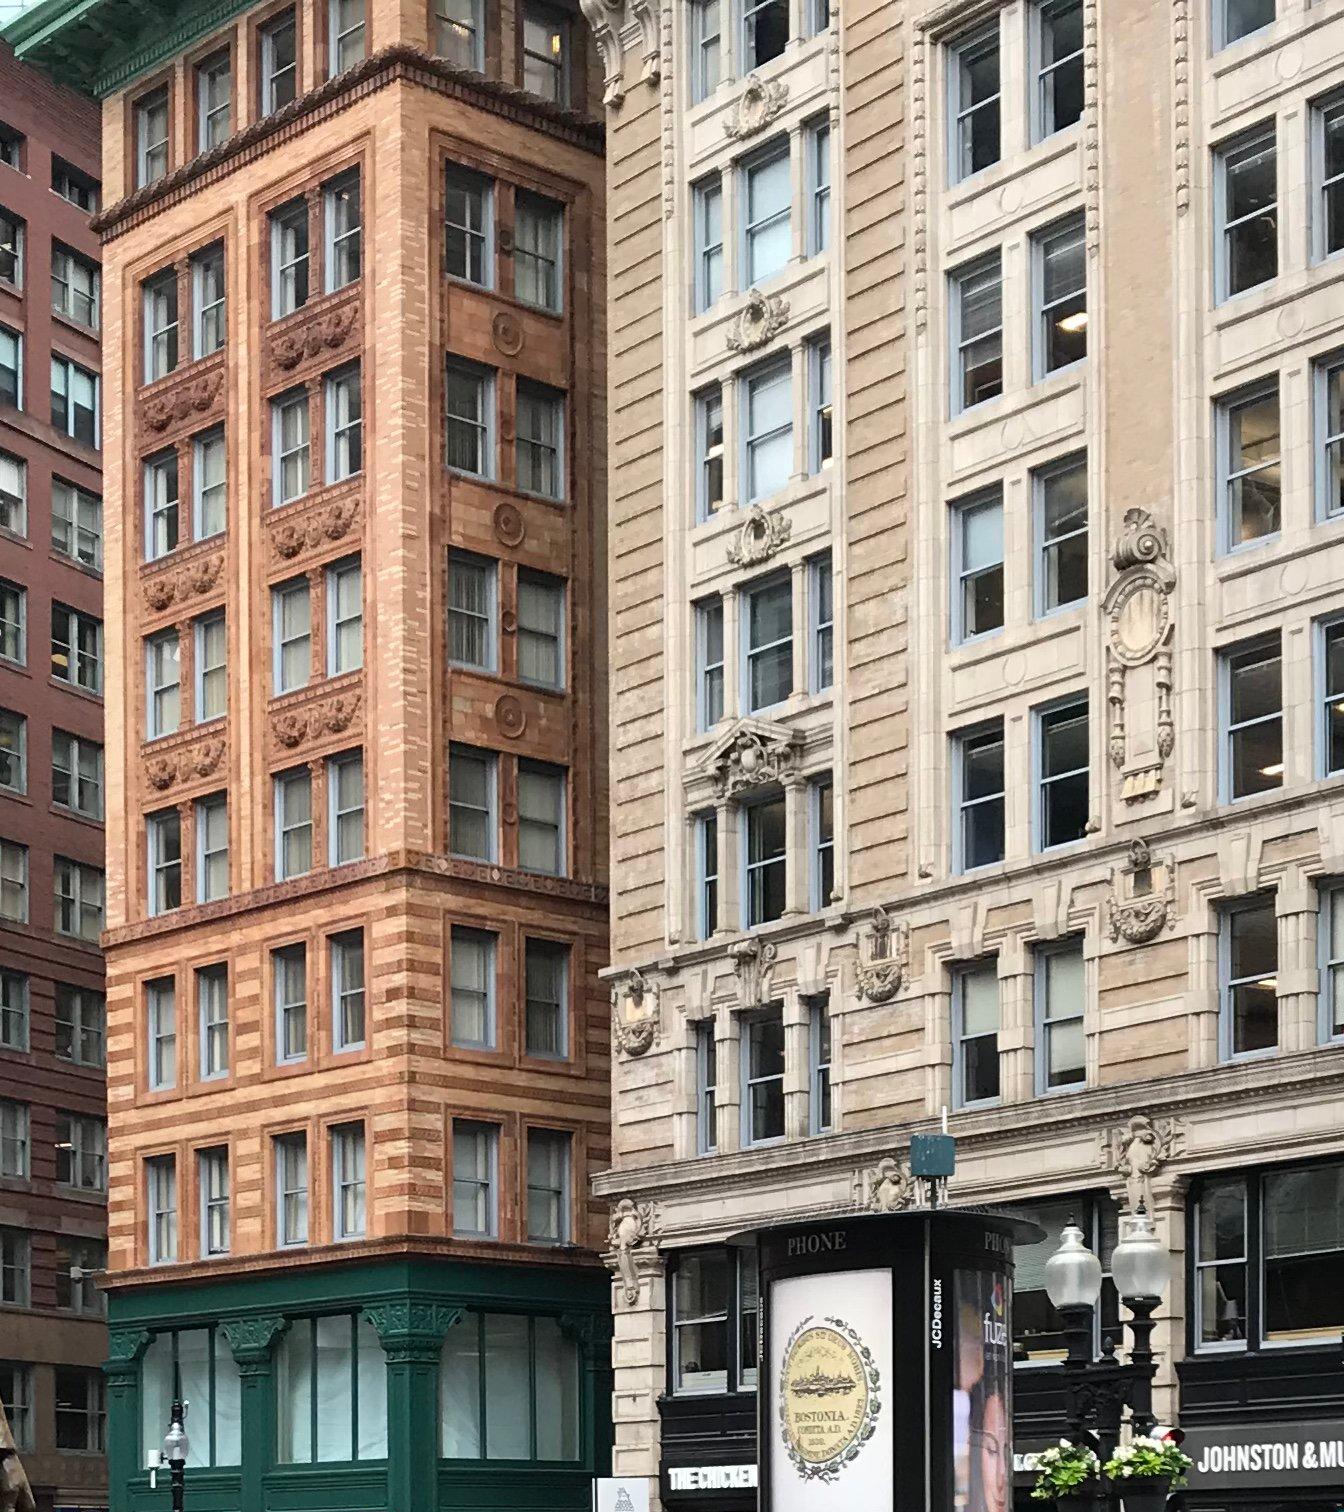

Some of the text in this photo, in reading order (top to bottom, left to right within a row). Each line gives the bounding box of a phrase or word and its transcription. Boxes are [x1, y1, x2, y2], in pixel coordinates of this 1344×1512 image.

[788, 1231, 847, 1256] PHONE
[931, 1278, 942, 1349] JCDecaux
[1197, 1442, 1299, 1473] JOHNSTON
[1302, 1441, 1319, 1468] &
[668, 1467, 699, 1490] THE
